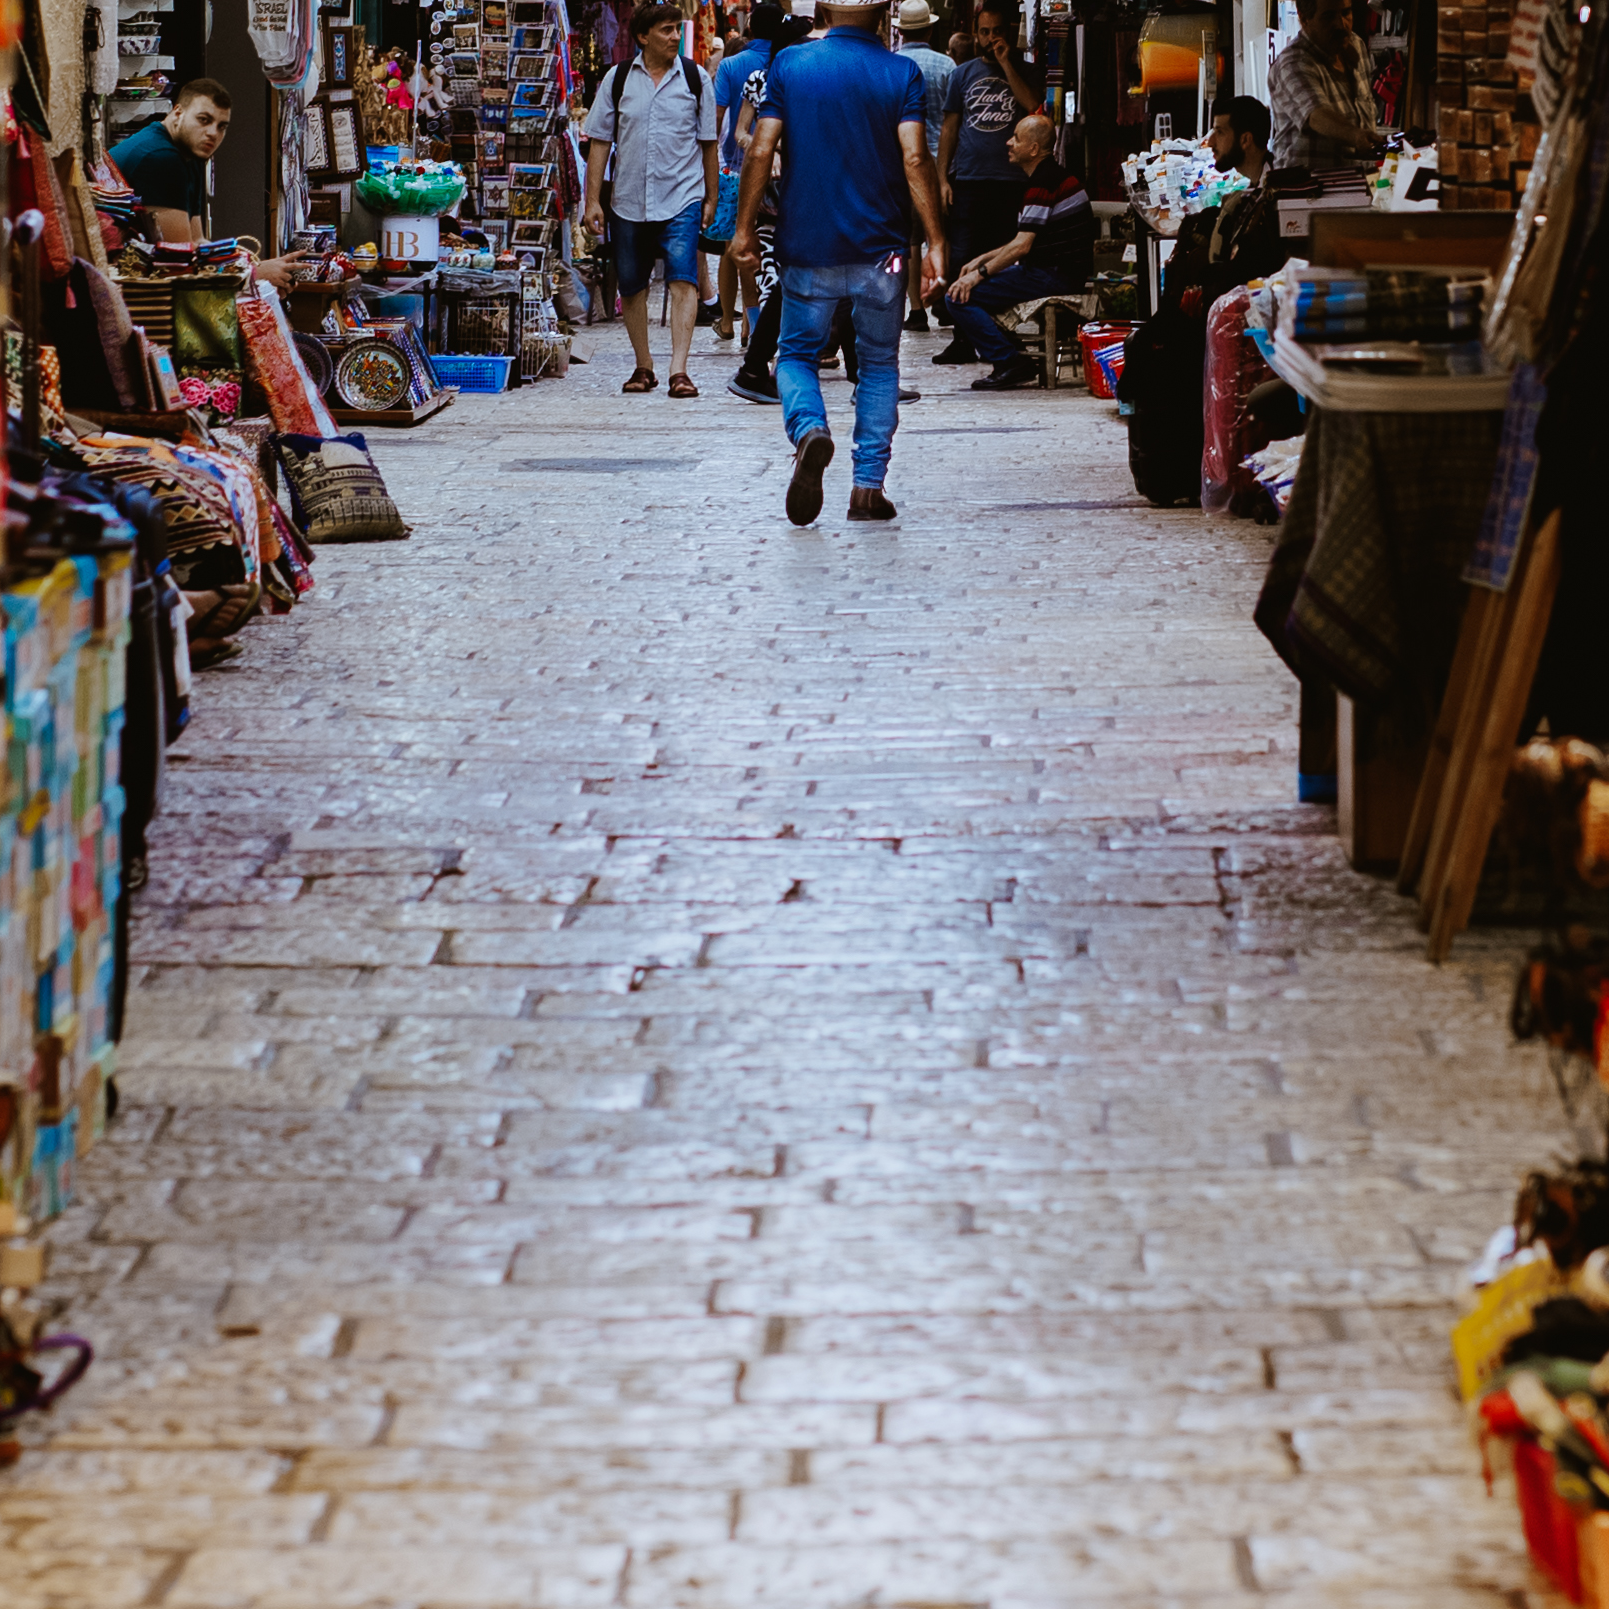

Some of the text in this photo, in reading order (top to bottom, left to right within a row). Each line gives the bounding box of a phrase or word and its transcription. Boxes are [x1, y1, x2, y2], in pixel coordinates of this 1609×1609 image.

[255, 3, 288, 14] ISRAEL
[966, 85, 1016, 111] Jack &
[967, 103, 1016, 128] Jones
[382, 230, 420, 258] HB
